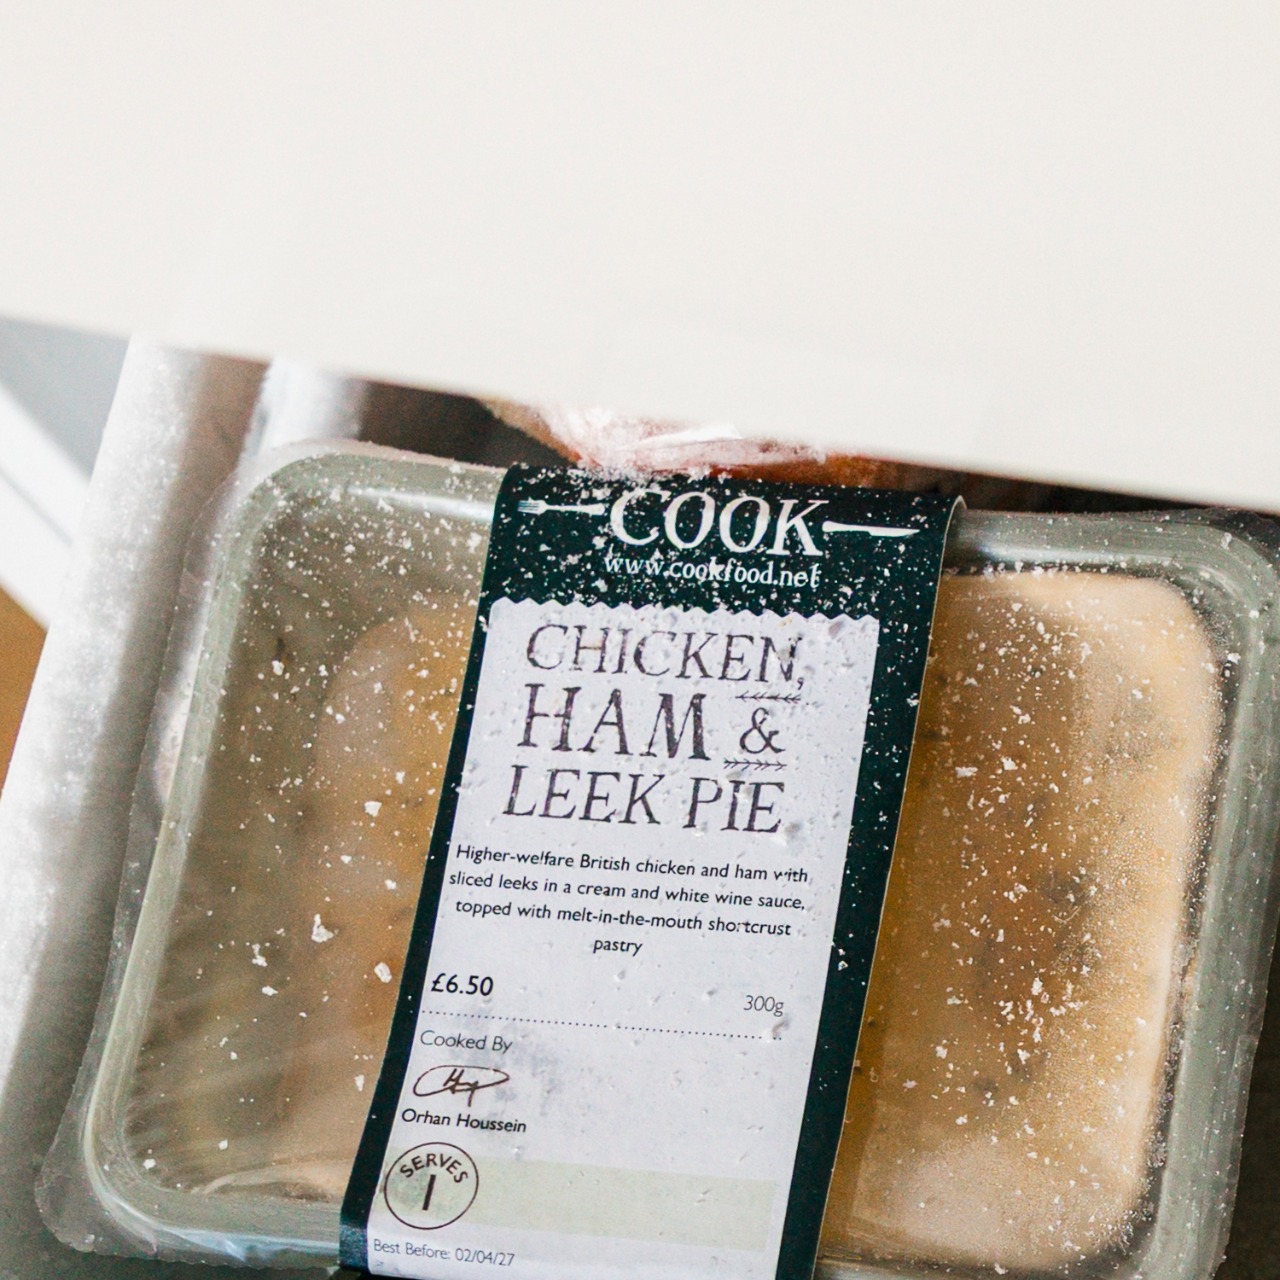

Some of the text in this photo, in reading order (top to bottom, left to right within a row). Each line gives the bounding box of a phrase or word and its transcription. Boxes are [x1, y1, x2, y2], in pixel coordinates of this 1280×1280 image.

[609, 488, 829, 556] COOK
[604, 557, 820, 589] www.cookfood.net
[527, 623, 804, 690] CHICKEN,
[517, 683, 785, 761] HAM &
[503, 764, 785, 834] LEEK PIE
[456, 844, 808, 882] Higher-welfare British chicken and ham with
[450, 871, 804, 910] sliced leeks in a cream and white wine sauce,
[456, 901, 512, 918] topped
[518, 904, 551, 918] with
[557, 907, 702, 929] melt-in-the-mouth
[593, 940, 643, 957] pastry
[431, 973, 493, 996] £6.50
[744, 995, 784, 1017] 300g
[421, 1030, 513, 1054] Cooked By
[402, 1108, 526, 1132] Orhan Houssein
[400, 1153, 469, 1184] SERVES
[374, 1239, 515, 1266] Best Before: 02/04/27
